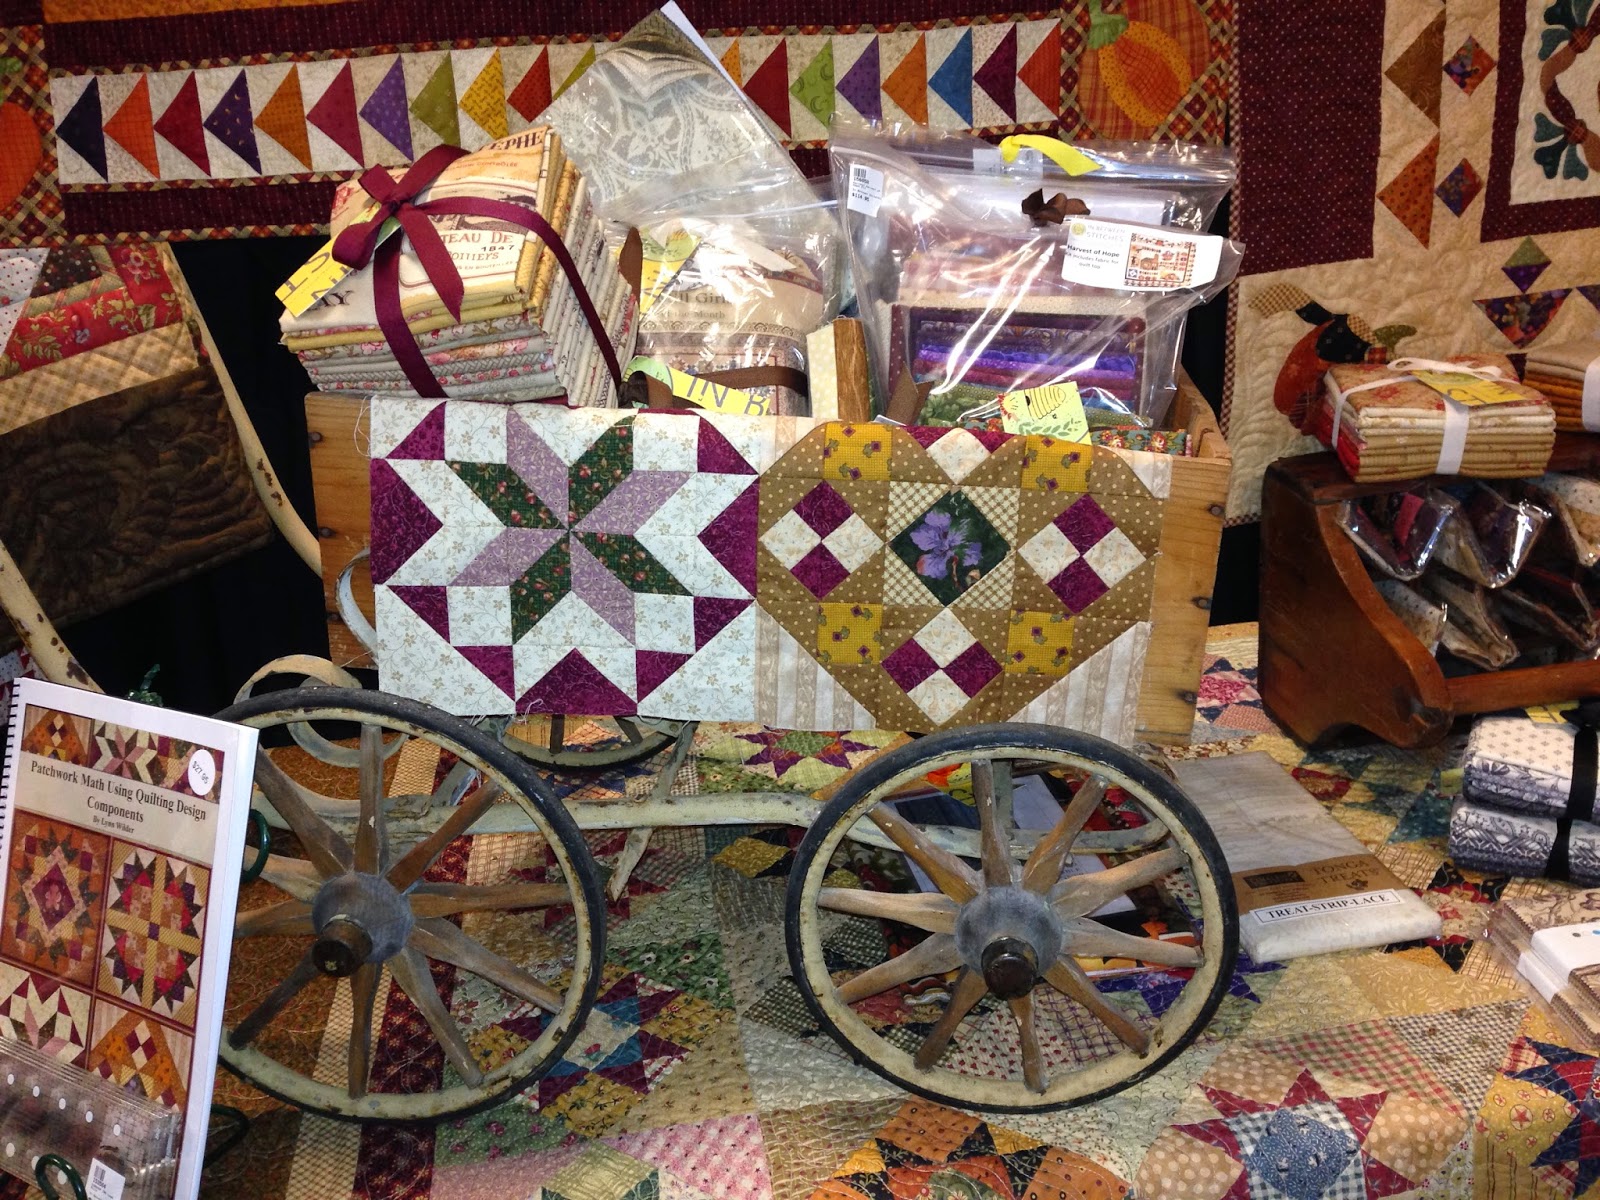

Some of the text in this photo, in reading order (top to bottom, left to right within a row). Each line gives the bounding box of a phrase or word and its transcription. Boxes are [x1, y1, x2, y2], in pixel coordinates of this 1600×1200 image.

[481, 245, 515, 253] 1847
[1067, 245, 1092, 254] Harvest
[1102, 250, 1120, 258] Hope
[31, 760, 206, 821] Patchwork Math Using Quilting Design
[87, 796, 144, 823] Components
[93, 816, 135, 834] By Lynn Wilder
[1313, 859, 1370, 876] TONGA
[1267, 895, 1389, 919] TREAT-STRIP-LACE
